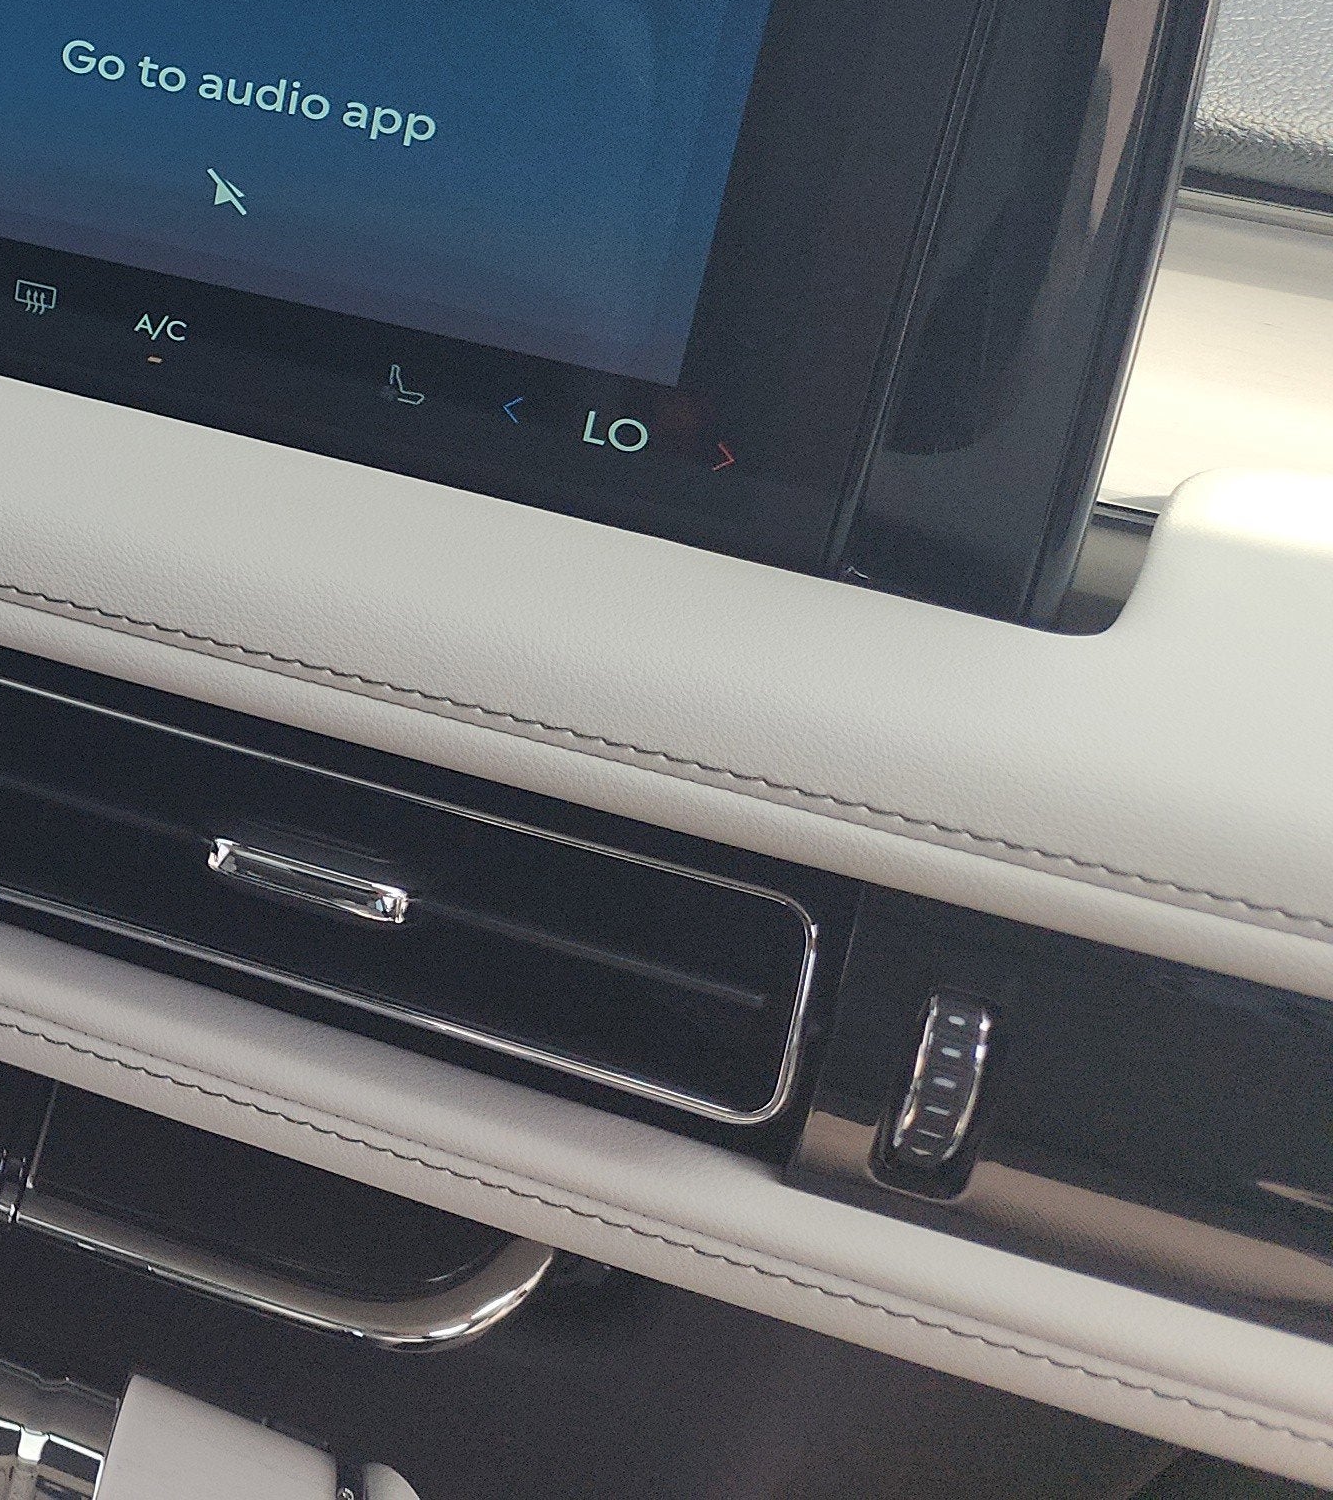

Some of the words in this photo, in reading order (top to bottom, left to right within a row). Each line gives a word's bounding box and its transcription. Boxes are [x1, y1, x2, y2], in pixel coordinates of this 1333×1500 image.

[60, 38, 126, 84] Go
[137, 52, 188, 97] to
[196, 64, 331, 123] audio
[340, 95, 438, 149] app
[133, 310, 188, 346] A/C
[581, 411, 649, 454] LO
